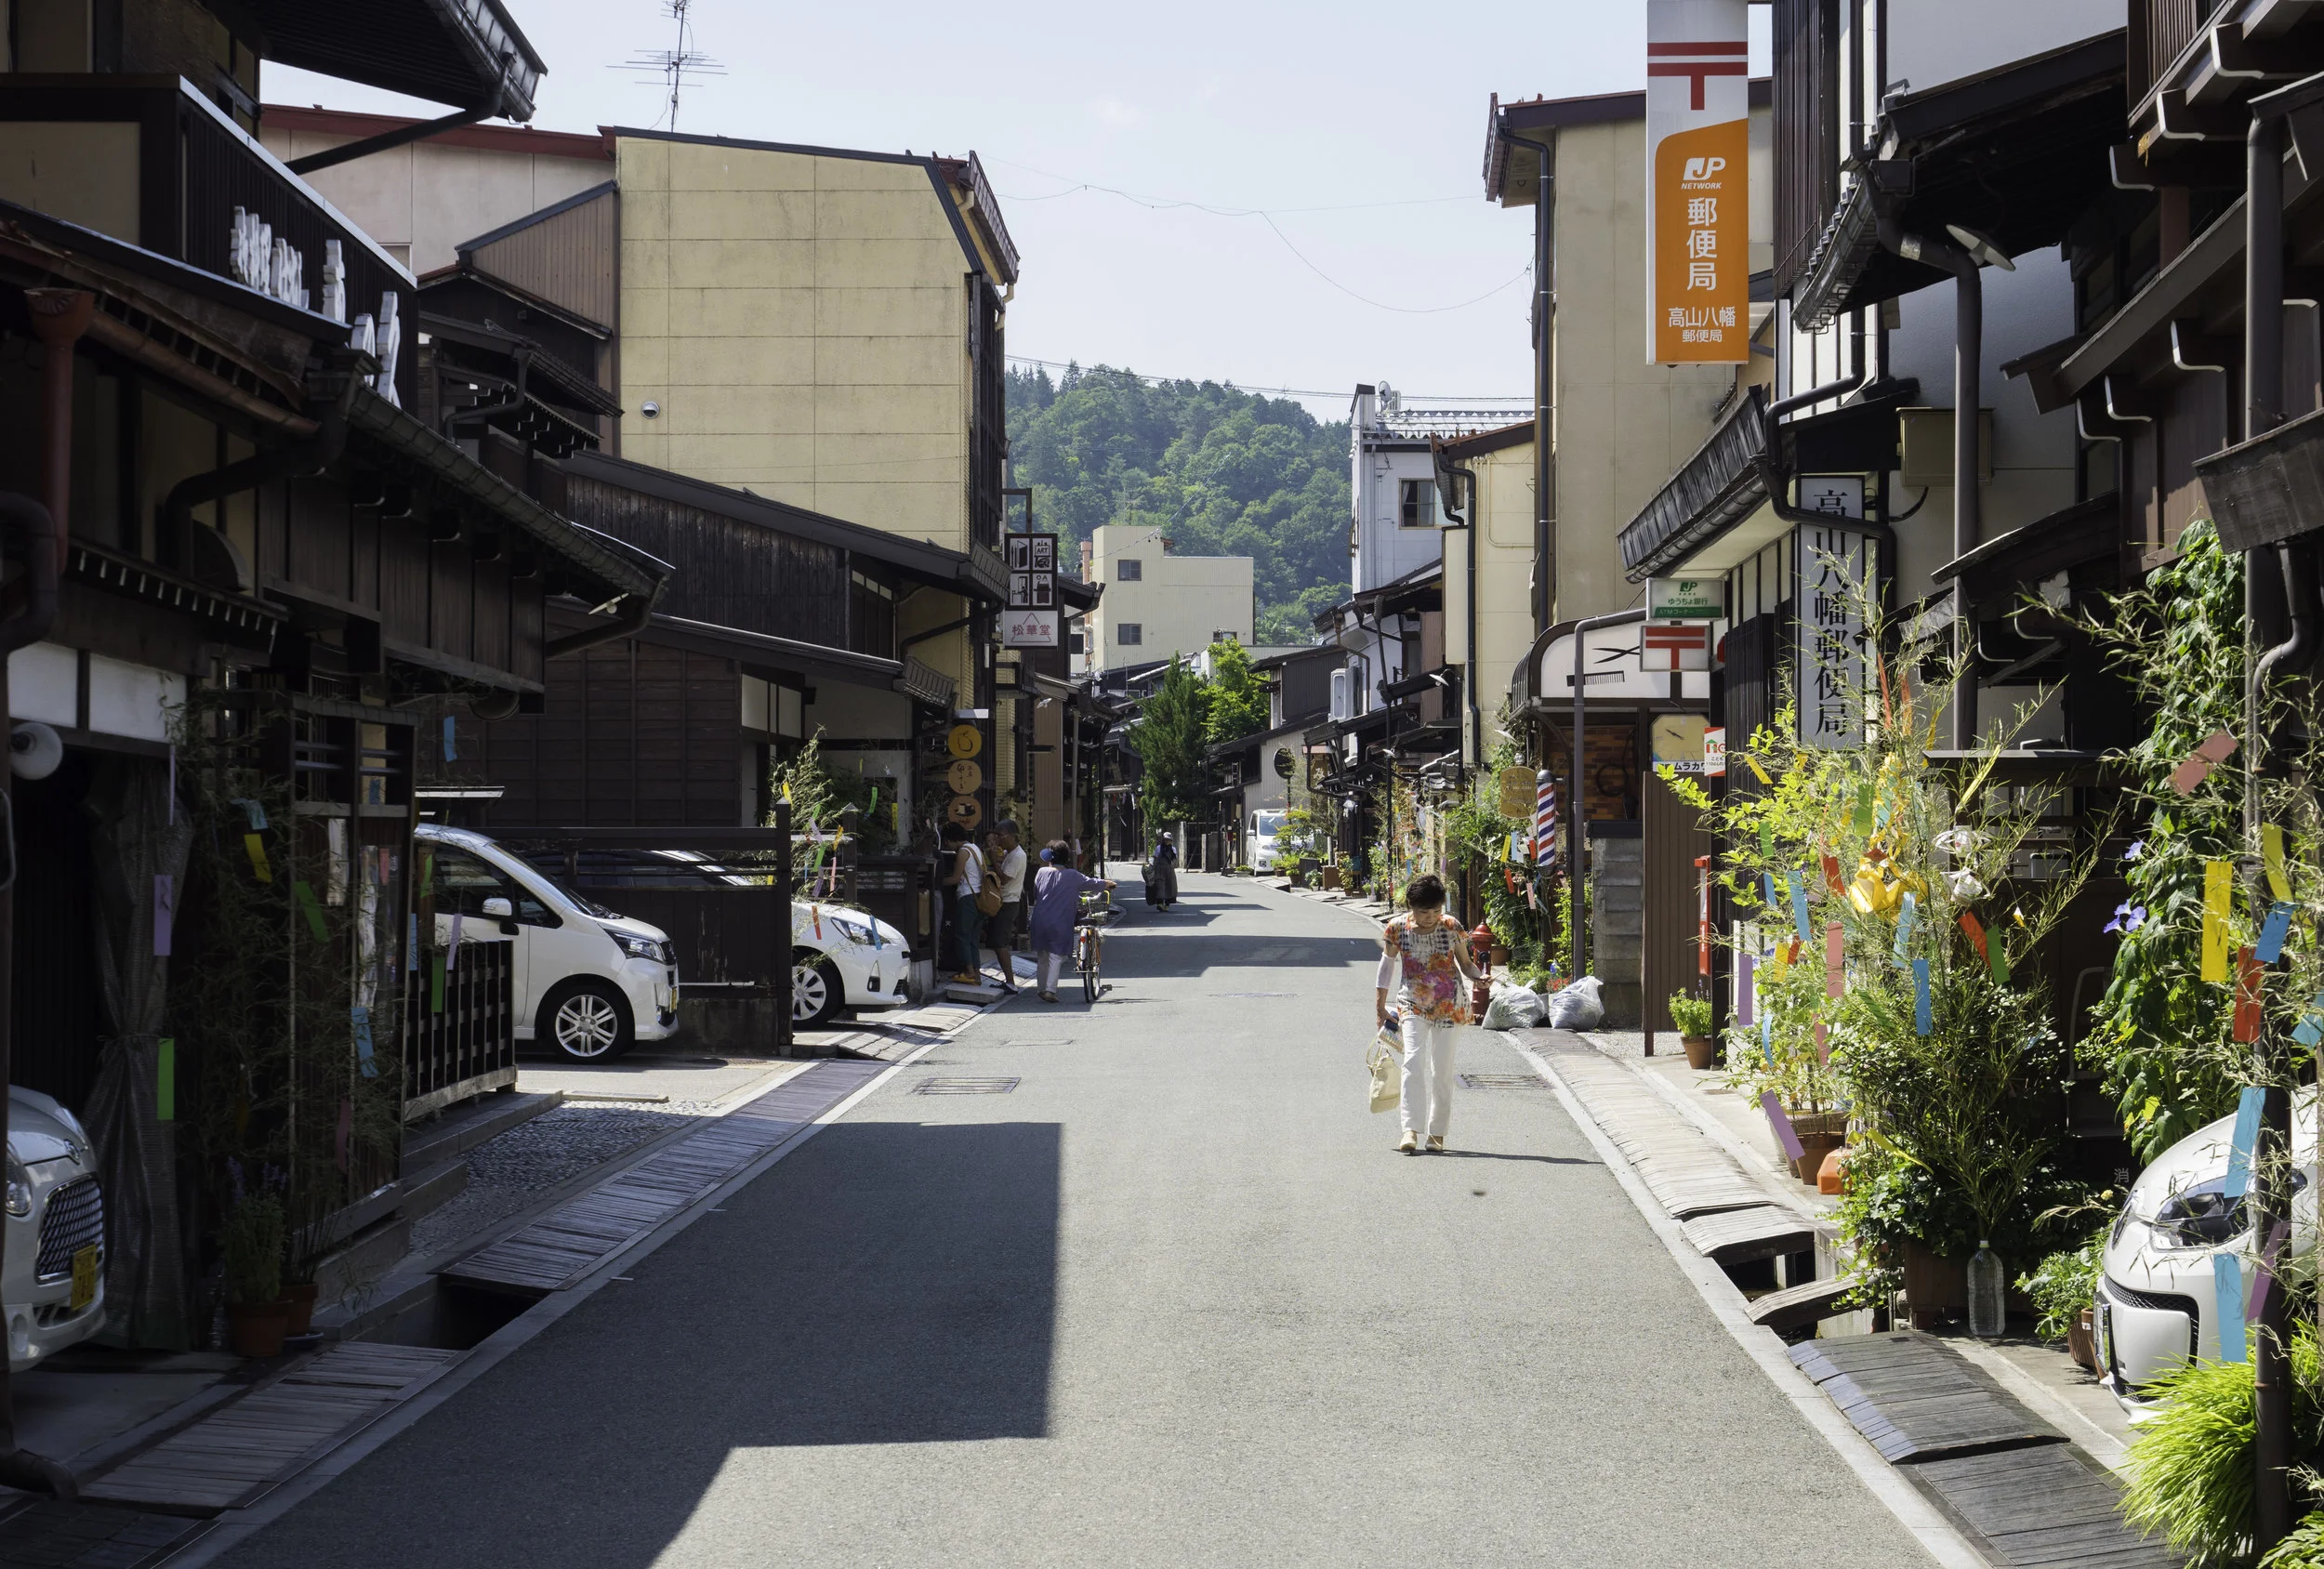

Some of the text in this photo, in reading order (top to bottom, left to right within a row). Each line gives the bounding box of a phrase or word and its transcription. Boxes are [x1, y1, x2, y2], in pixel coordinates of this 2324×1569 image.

[1683, 157, 1726, 181] JP
[1681, 182, 1722, 191] NETWORK
[1686, 197, 1718, 291] 郵便局
[1668, 306, 1736, 328] 高山八幡
[1682, 329, 1723, 343] 郵便局
[1680, 581, 1697, 592] JP
[1668, 598, 1709, 606] ゆうちょ銀行
[1011, 624, 1051, 636] 松華堂
[2113, 1167, 2130, 1183] 消
